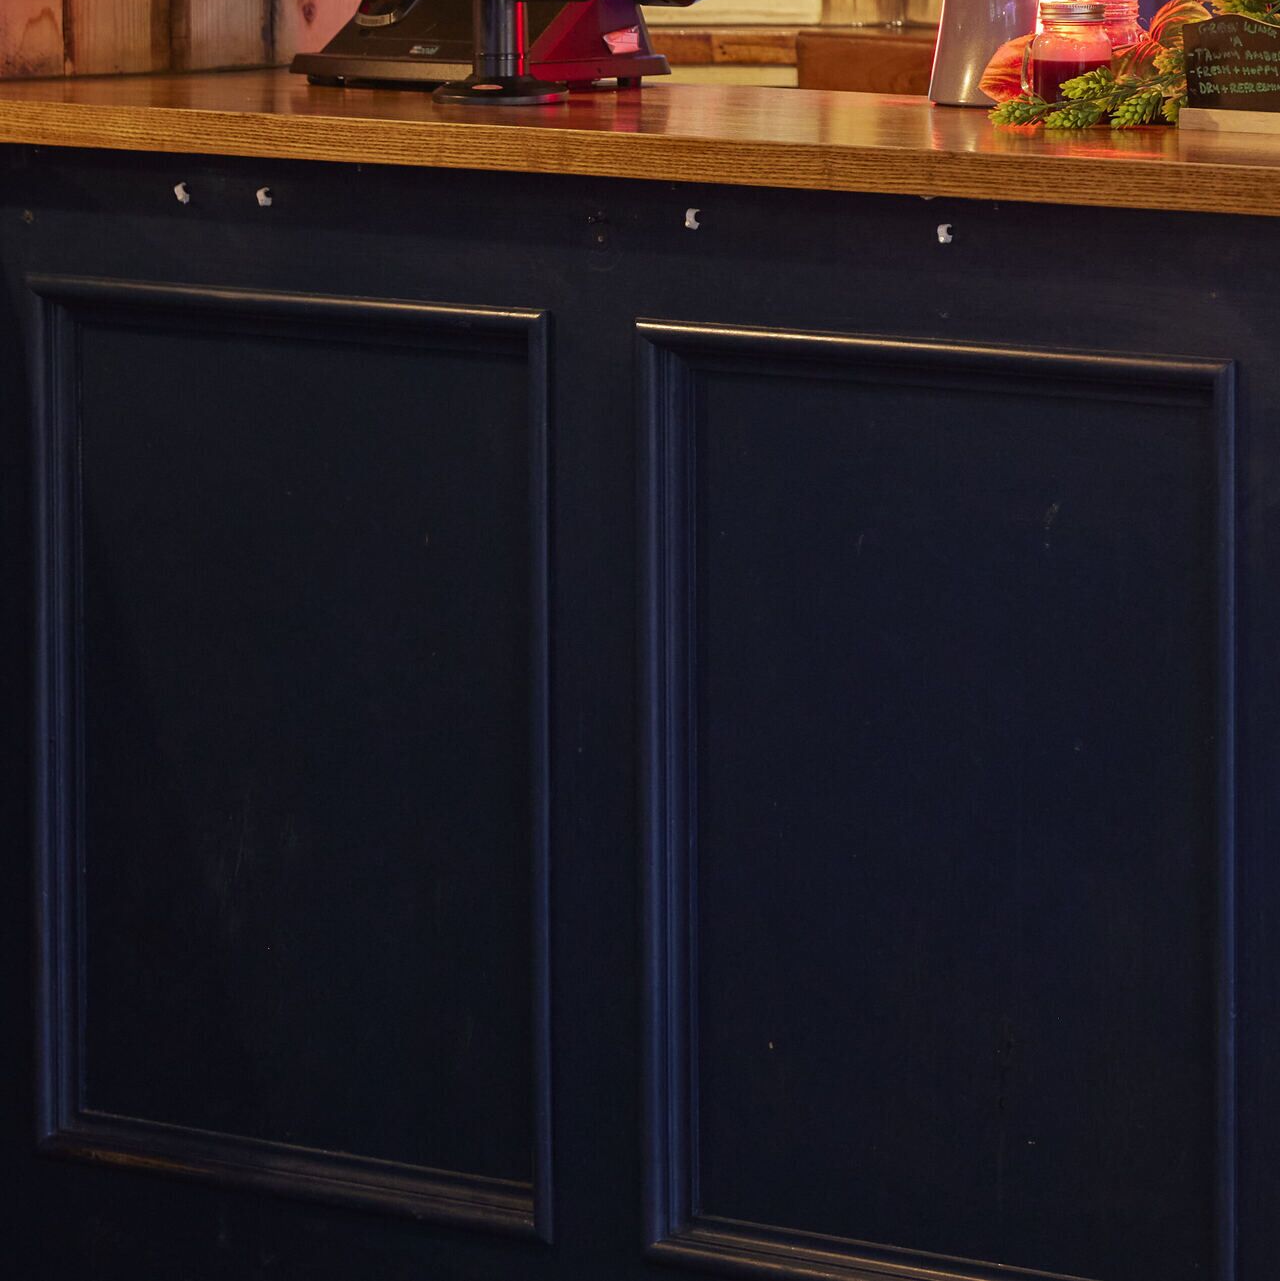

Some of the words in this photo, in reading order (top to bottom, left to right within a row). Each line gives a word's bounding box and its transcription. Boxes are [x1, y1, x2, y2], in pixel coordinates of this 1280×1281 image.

[1196, 65, 1231, 78] FRESH
[1242, 65, 1279, 77] HOPPY
[1199, 82, 1220, 94] DRY
